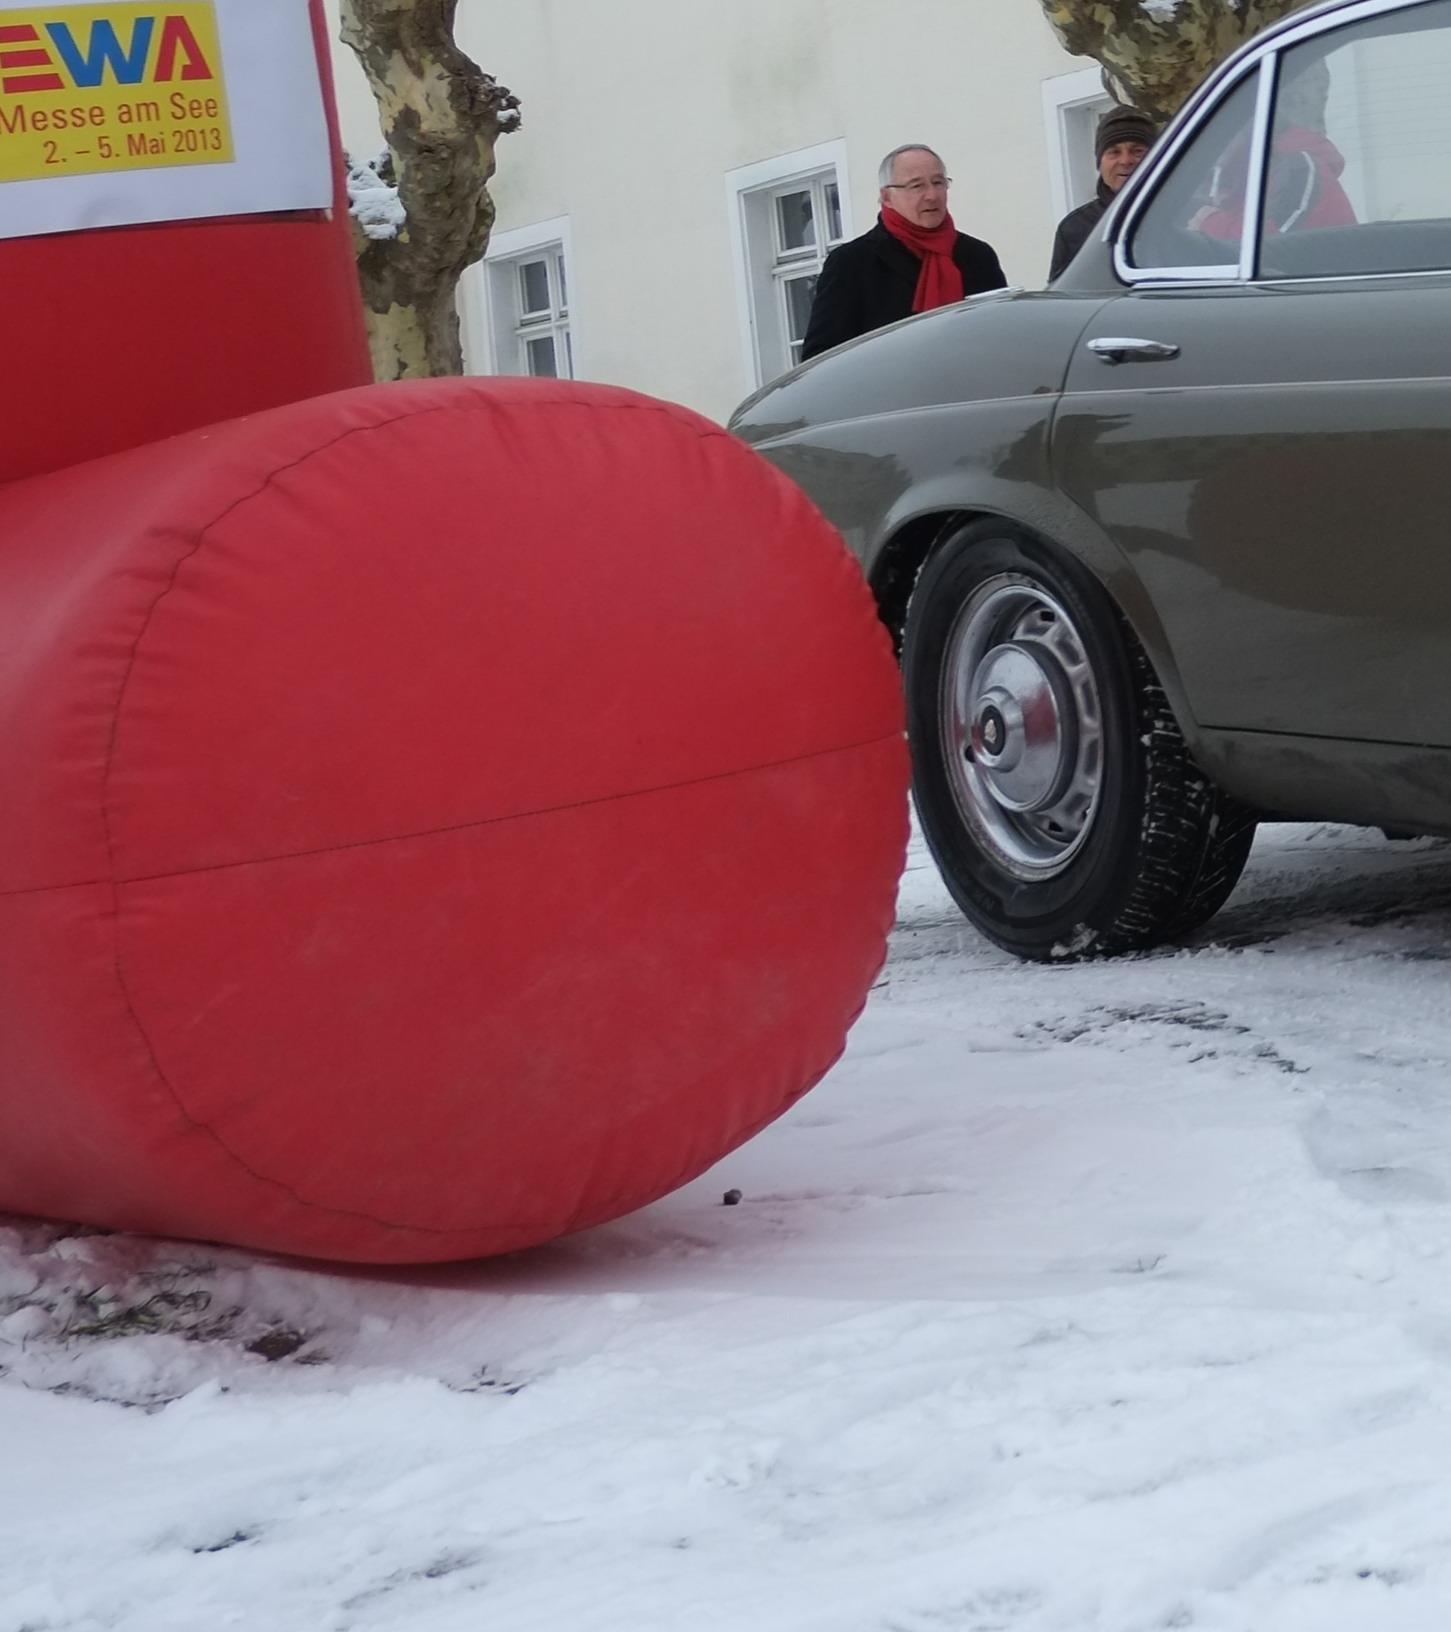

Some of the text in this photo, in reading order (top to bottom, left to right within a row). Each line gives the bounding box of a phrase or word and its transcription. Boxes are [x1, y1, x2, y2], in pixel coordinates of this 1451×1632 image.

[0, 92, 218, 134] Messe am See
[43, 140, 67, 164] 2.
[98, 135, 120, 159] 5.
[127, 132, 166, 156] Mai
[172, 127, 222, 153] 2013
